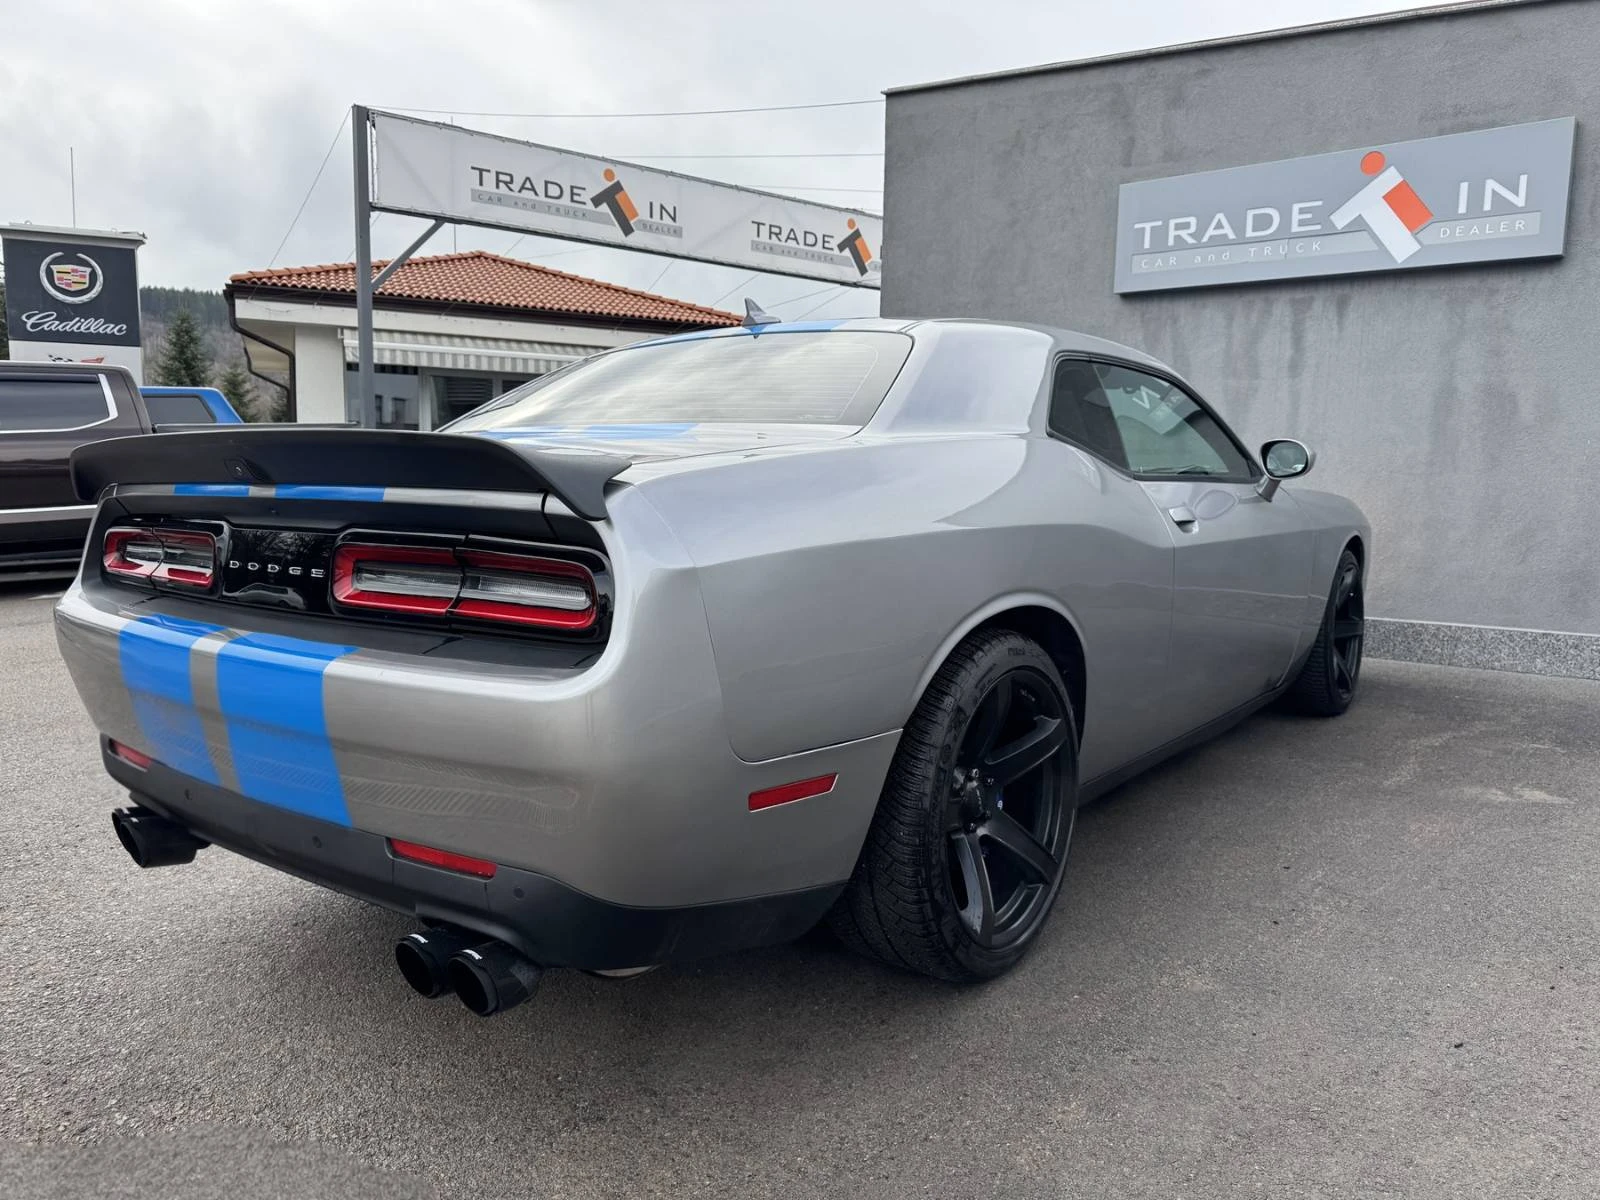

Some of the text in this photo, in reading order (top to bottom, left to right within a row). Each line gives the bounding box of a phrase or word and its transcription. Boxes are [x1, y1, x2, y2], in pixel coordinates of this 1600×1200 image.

[470, 166, 587, 205] TRADE
[649, 201, 678, 223] IN
[478, 193, 679, 235] CAR and TRUCK DEALER
[1134, 200, 1324, 249] TRADE
[1457, 174, 1528, 214] IN
[751, 220, 835, 251] TRADE
[1140, 219, 1526, 269] CAR and TRUCK DEALER
[21, 311, 127, 336] Cadillac
[229, 560, 325, 578] DODGE
